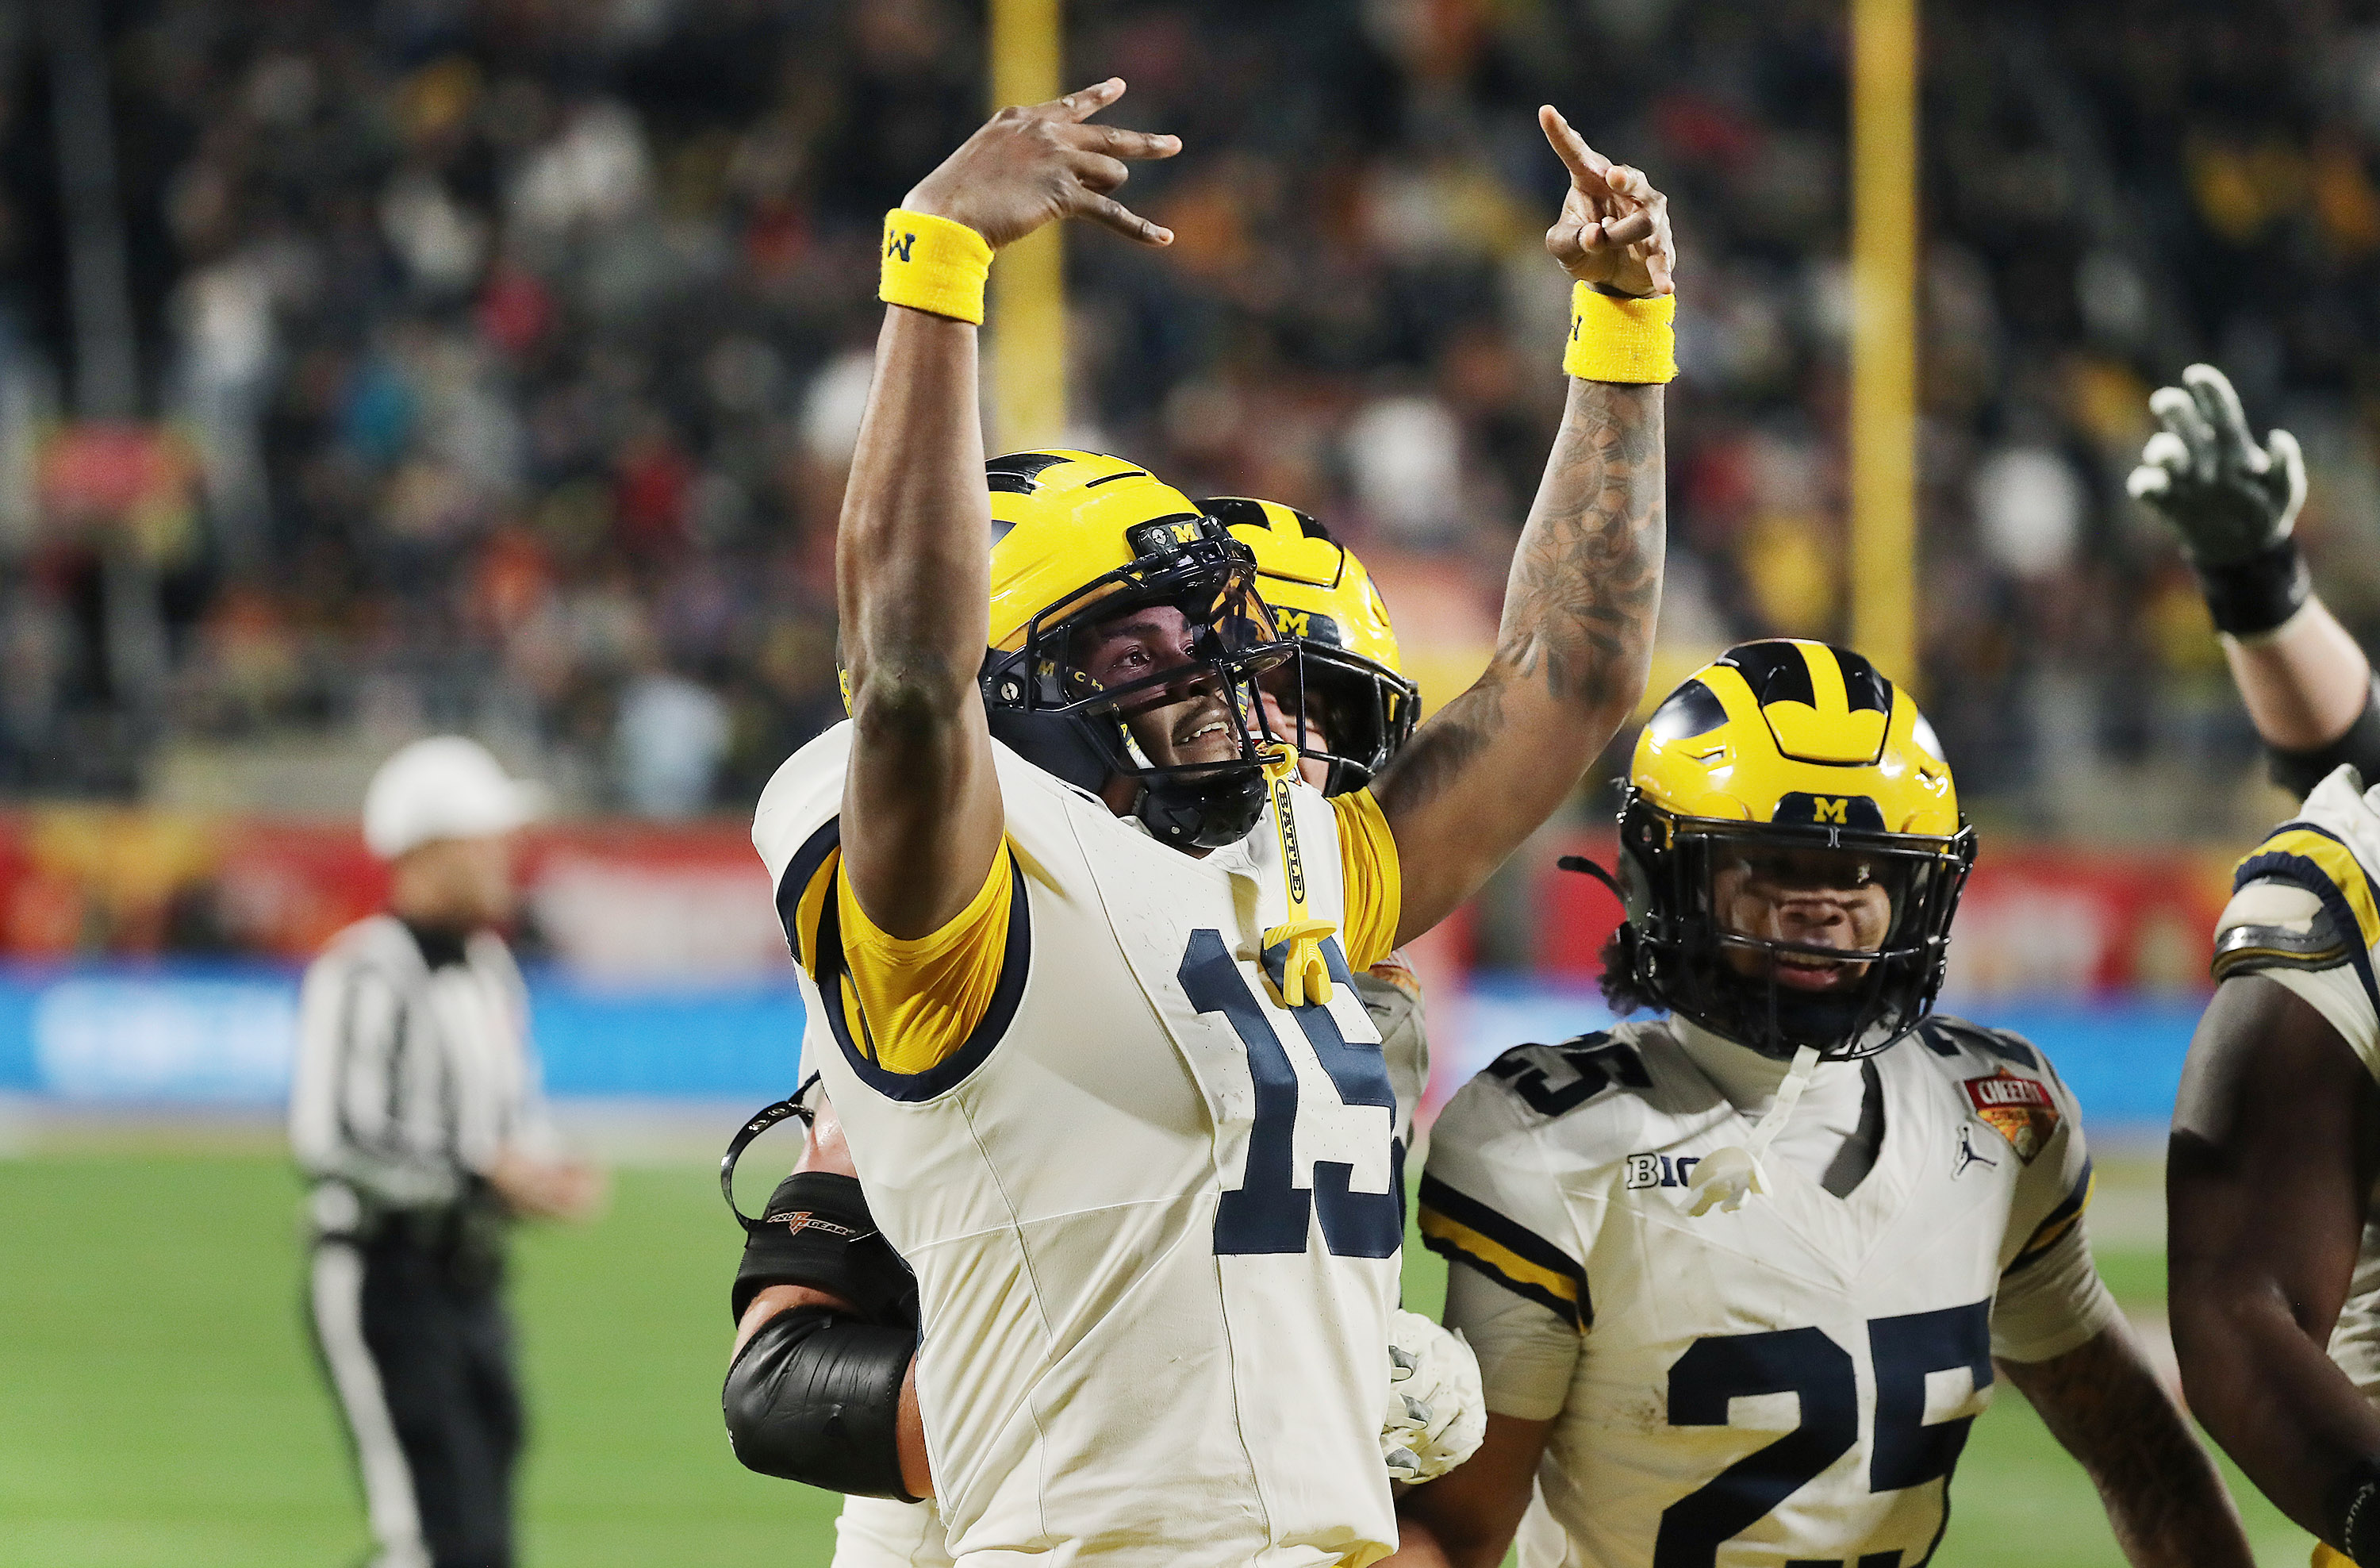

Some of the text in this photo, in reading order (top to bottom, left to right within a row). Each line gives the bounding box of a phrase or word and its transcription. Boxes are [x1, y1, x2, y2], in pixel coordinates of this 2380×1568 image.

[1169, 522, 1200, 544] M
[1276, 607, 1311, 637] M
[1813, 796, 1848, 824] M
[1278, 790, 1303, 892] BATTLE
[808, 1220, 848, 1236] GEAR
[1653, 1296, 1994, 1568] 25
